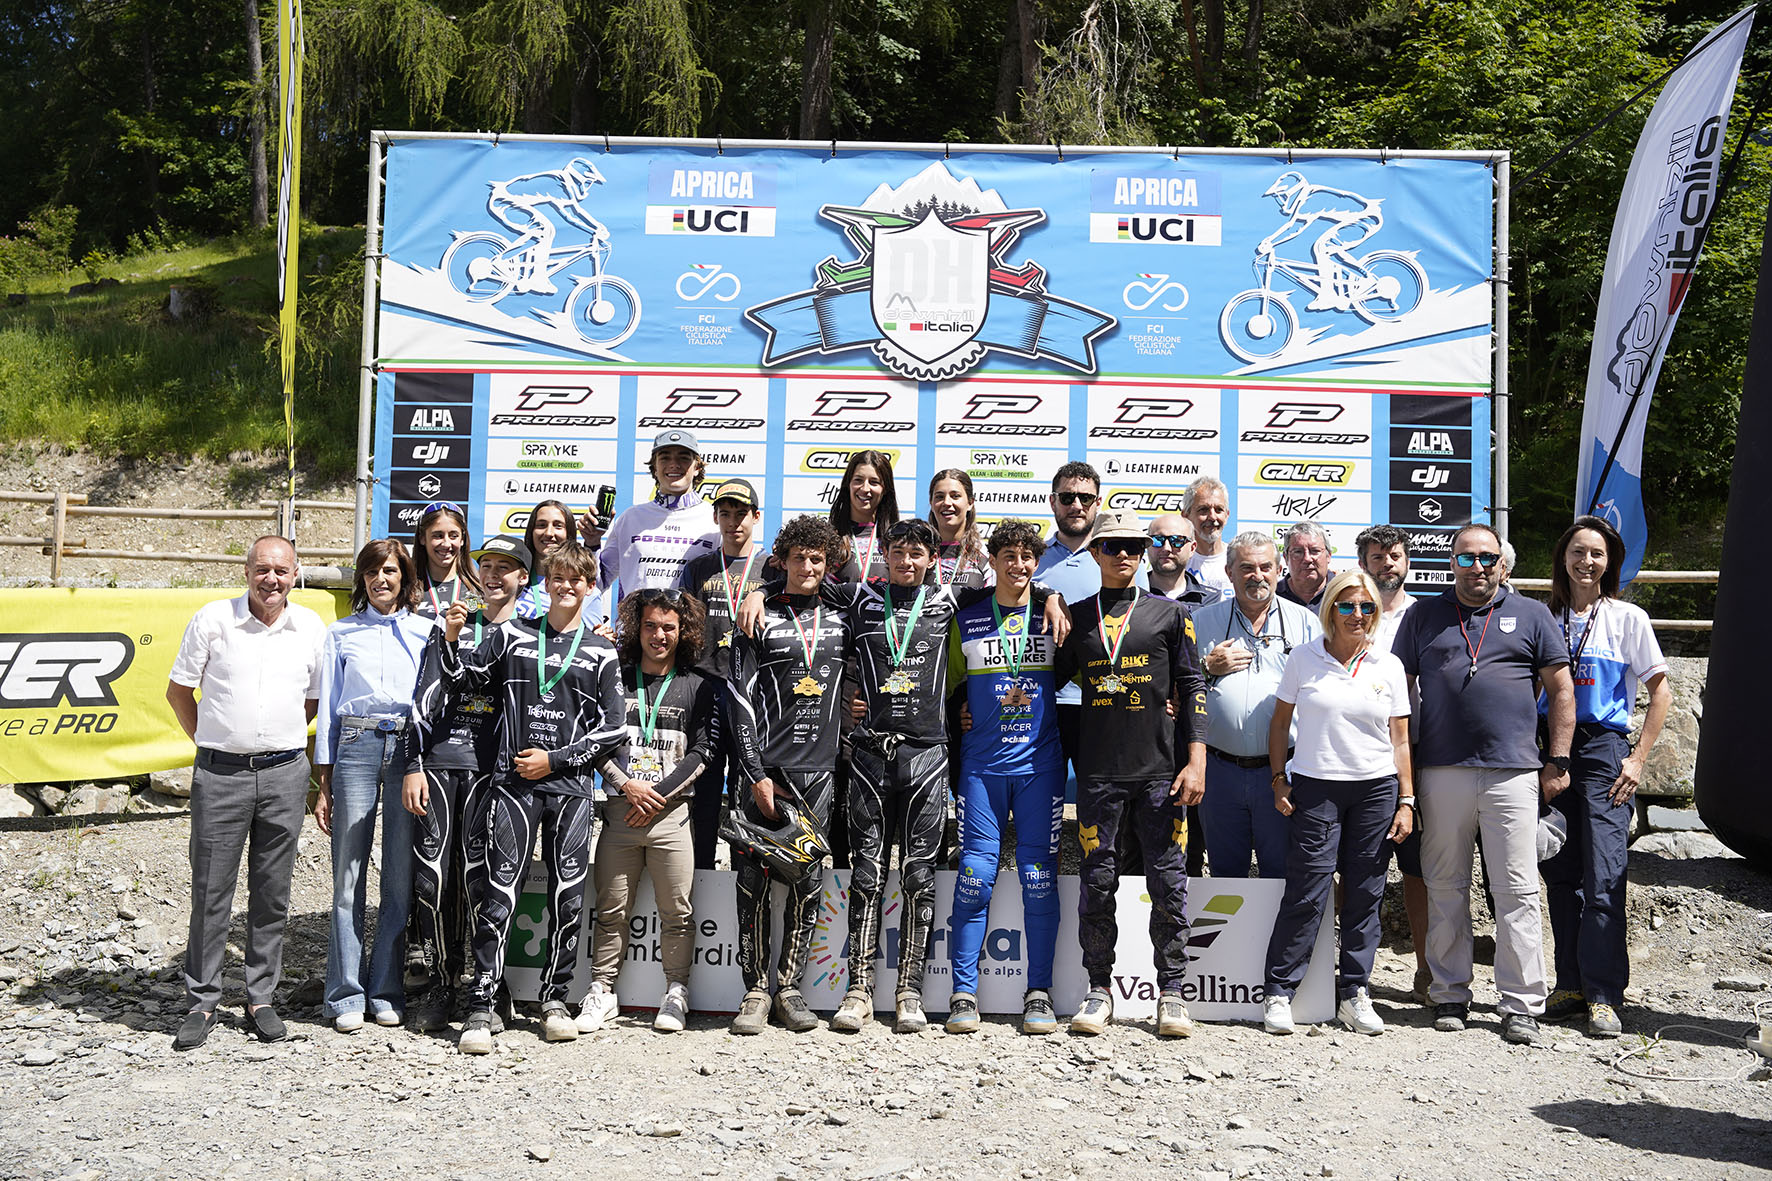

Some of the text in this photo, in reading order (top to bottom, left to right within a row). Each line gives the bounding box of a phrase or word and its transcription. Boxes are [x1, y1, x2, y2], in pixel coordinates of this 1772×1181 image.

[671, 170, 754, 199] APRICA
[1114, 177, 1198, 207] APRICA
[686, 209, 749, 233] UCI
[1132, 218, 1194, 242] UCI
[699, 315, 716, 324] FCI
[883, 308, 975, 322] downhill
[680, 325, 733, 334] FEDERAZIONE
[924, 321, 975, 333] italia
[1147, 324, 1164, 334] FCI
[685, 332, 727, 340] CICLISTICA
[688, 338, 724, 346] ITALIANA
[1128, 335, 1182, 343] FEDERAZIONE
[1134, 341, 1176, 349] CICLISTICA
[1136, 347, 1173, 356] ITALIANA
[410, 409, 455, 427] ALPA
[491, 414, 617, 427] PROGRIP
[638, 417, 766, 429] PROGRIP
[787, 420, 916, 432] PROGRIP
[937, 423, 1067, 436] PROGRIP
[1089, 426, 1218, 440] PROGRIP
[1240, 431, 1370, 445] PROGRIP
[1407, 431, 1454, 450] ALPA
[524, 443, 580, 457] SPRAYKE
[700, 453, 746, 464] HERMAN
[974, 453, 1028, 466] SPRAYKE
[1125, 463, 1199, 475] LEATHERMAN
[1260, 462, 1347, 483] GALFER
[524, 483, 596, 494] LEATHERMAN
[974, 492, 1047, 504] LEATHERMAN
[1108, 491, 1185, 511] GALFE
[631, 535, 713, 549] POSITIVE
[967, 625, 991, 634] MAVIC
[1121, 654, 1149, 666] BIKE
[527, 704, 566, 720] TRENTINO
[29, 718, 49, 736] a
[53, 713, 119, 735] PRO
[1001, 723, 1032, 732] RACER
[960, 875, 982, 887] TRIBE
[1025, 870, 1051, 881] TRIBE
[1027, 881, 1051, 890] RACER
[928, 965, 948, 975] fun
[995, 966, 1022, 978] alps
[1113, 974, 1266, 1004] Vaellina
